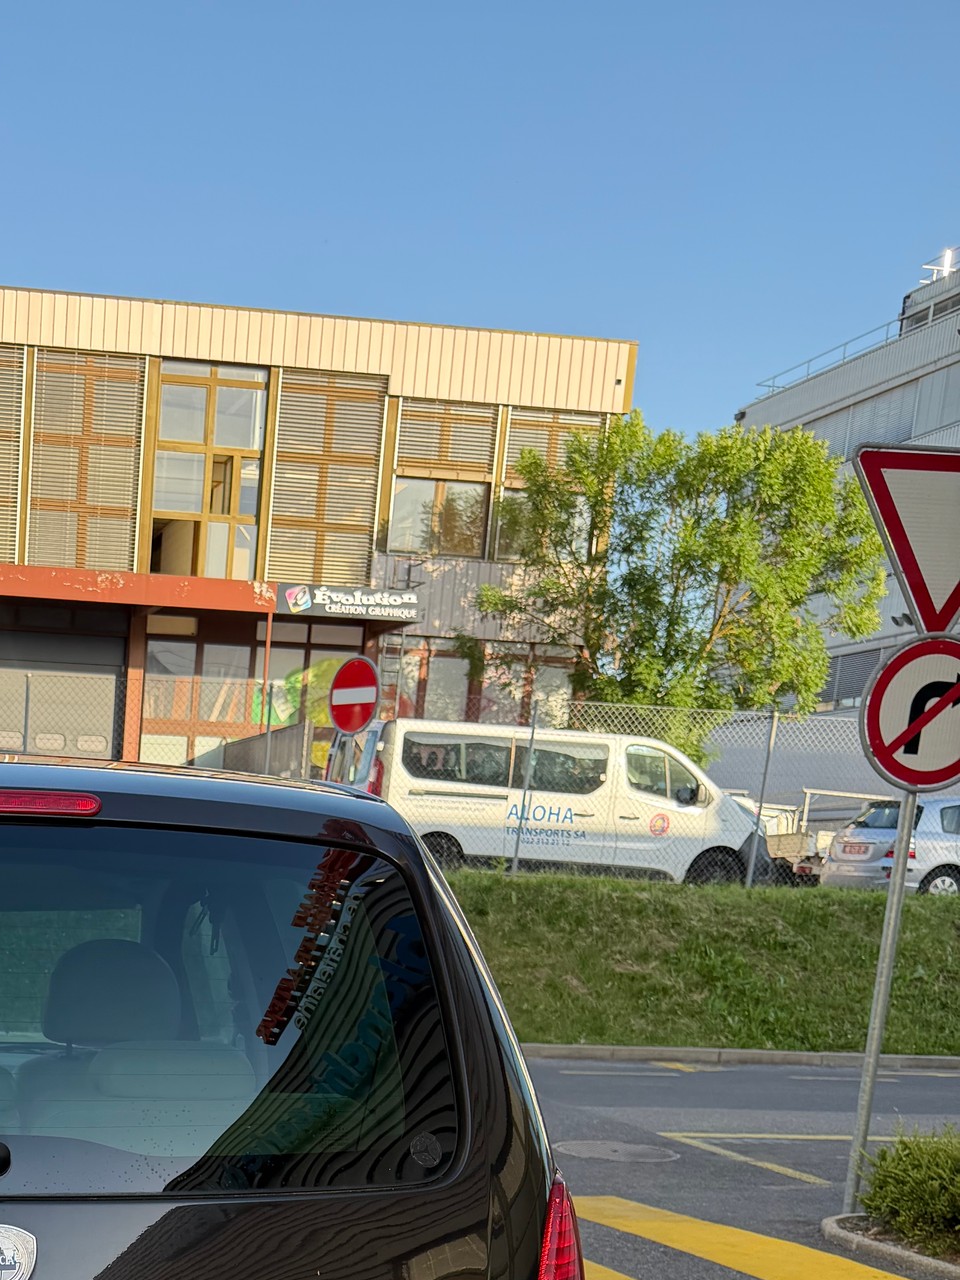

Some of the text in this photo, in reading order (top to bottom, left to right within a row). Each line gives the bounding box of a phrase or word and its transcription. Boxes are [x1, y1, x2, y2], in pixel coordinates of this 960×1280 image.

[313, 586, 418, 606] Évolution
[325, 603, 418, 619] CRÉATION GRAPHIQUE
[506, 803, 573, 824] ALOHA
[505, 826, 586, 839] TRANSPORTS SA
